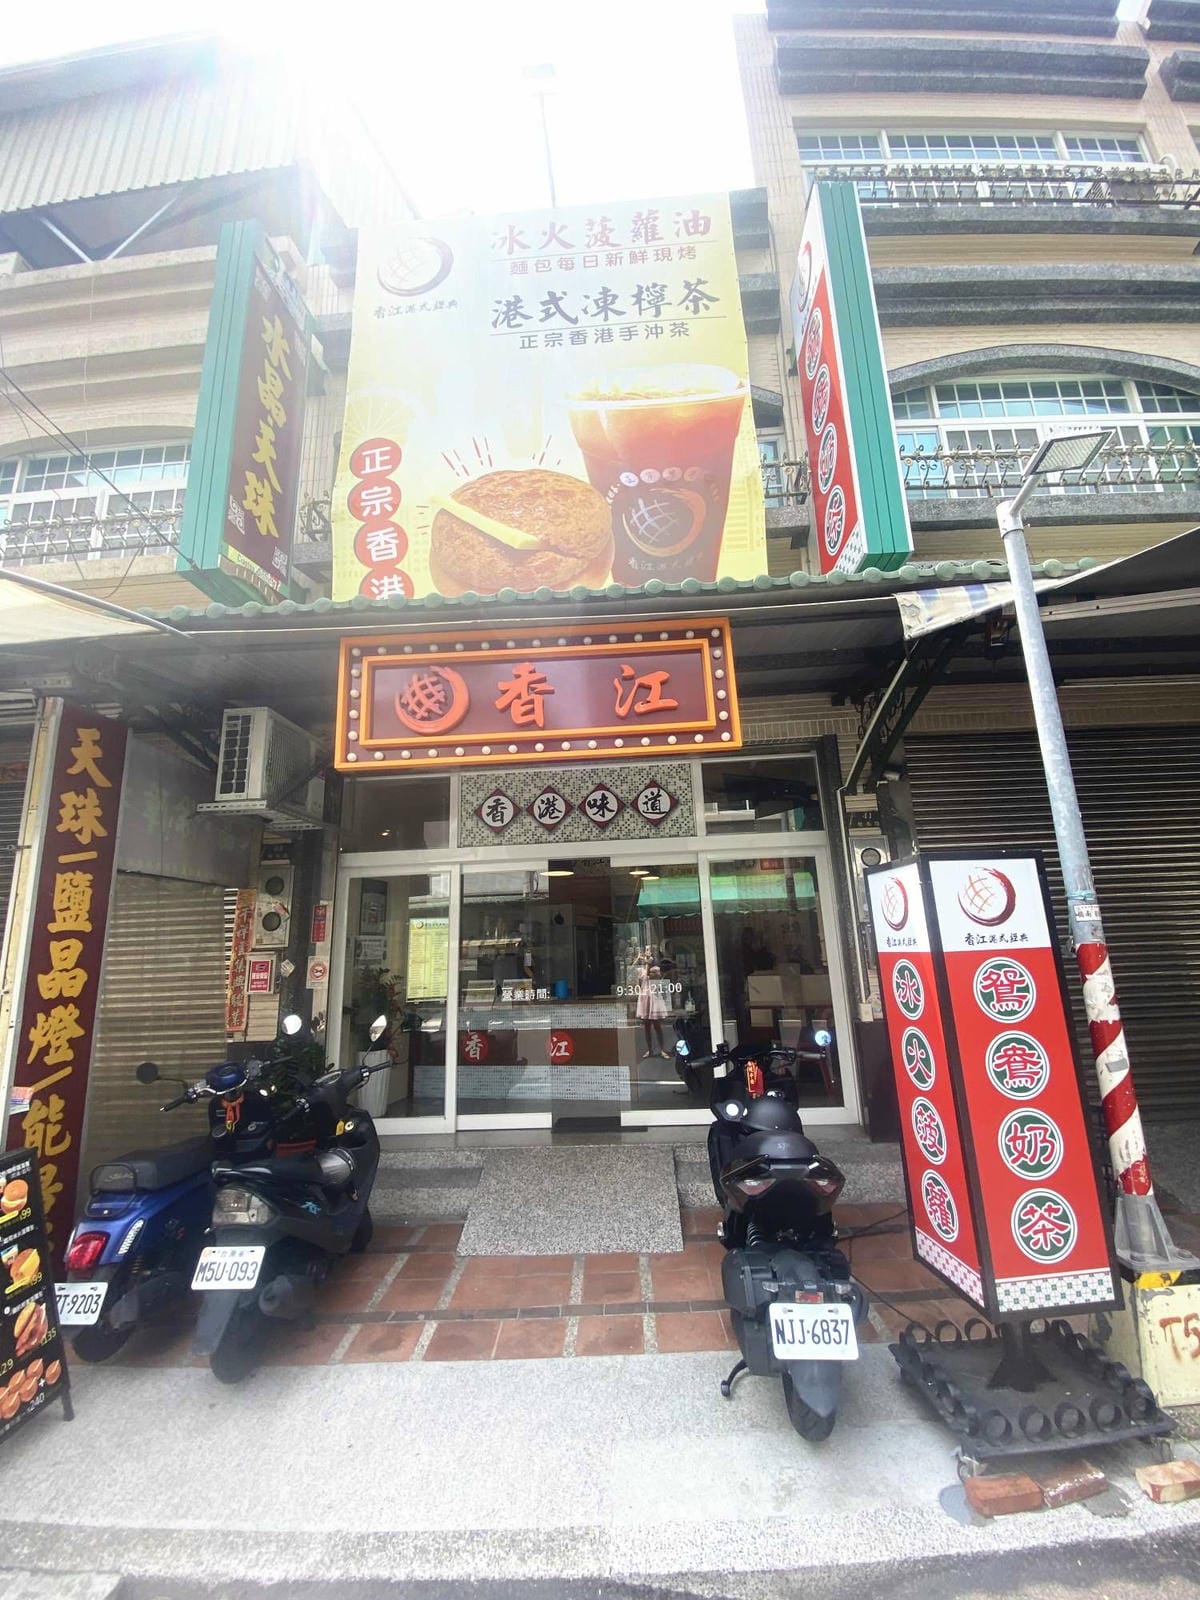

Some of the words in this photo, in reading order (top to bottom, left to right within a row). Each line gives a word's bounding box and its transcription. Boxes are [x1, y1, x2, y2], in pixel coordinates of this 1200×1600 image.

[490, 209, 713, 255] 冰火菠蘿油
[510, 247, 698, 275] 麵包每日新鮮現烤
[491, 278, 720, 330] 港式凍檸茶
[519, 322, 690, 350] 正宗香港手沖茶
[495, 662, 678, 728] 香江
[486, 790, 667, 824] 香港味道
[894, 975, 954, 1237] 冰火菠蘿
[980, 970, 1069, 1250] 鴛鴦奶茶
